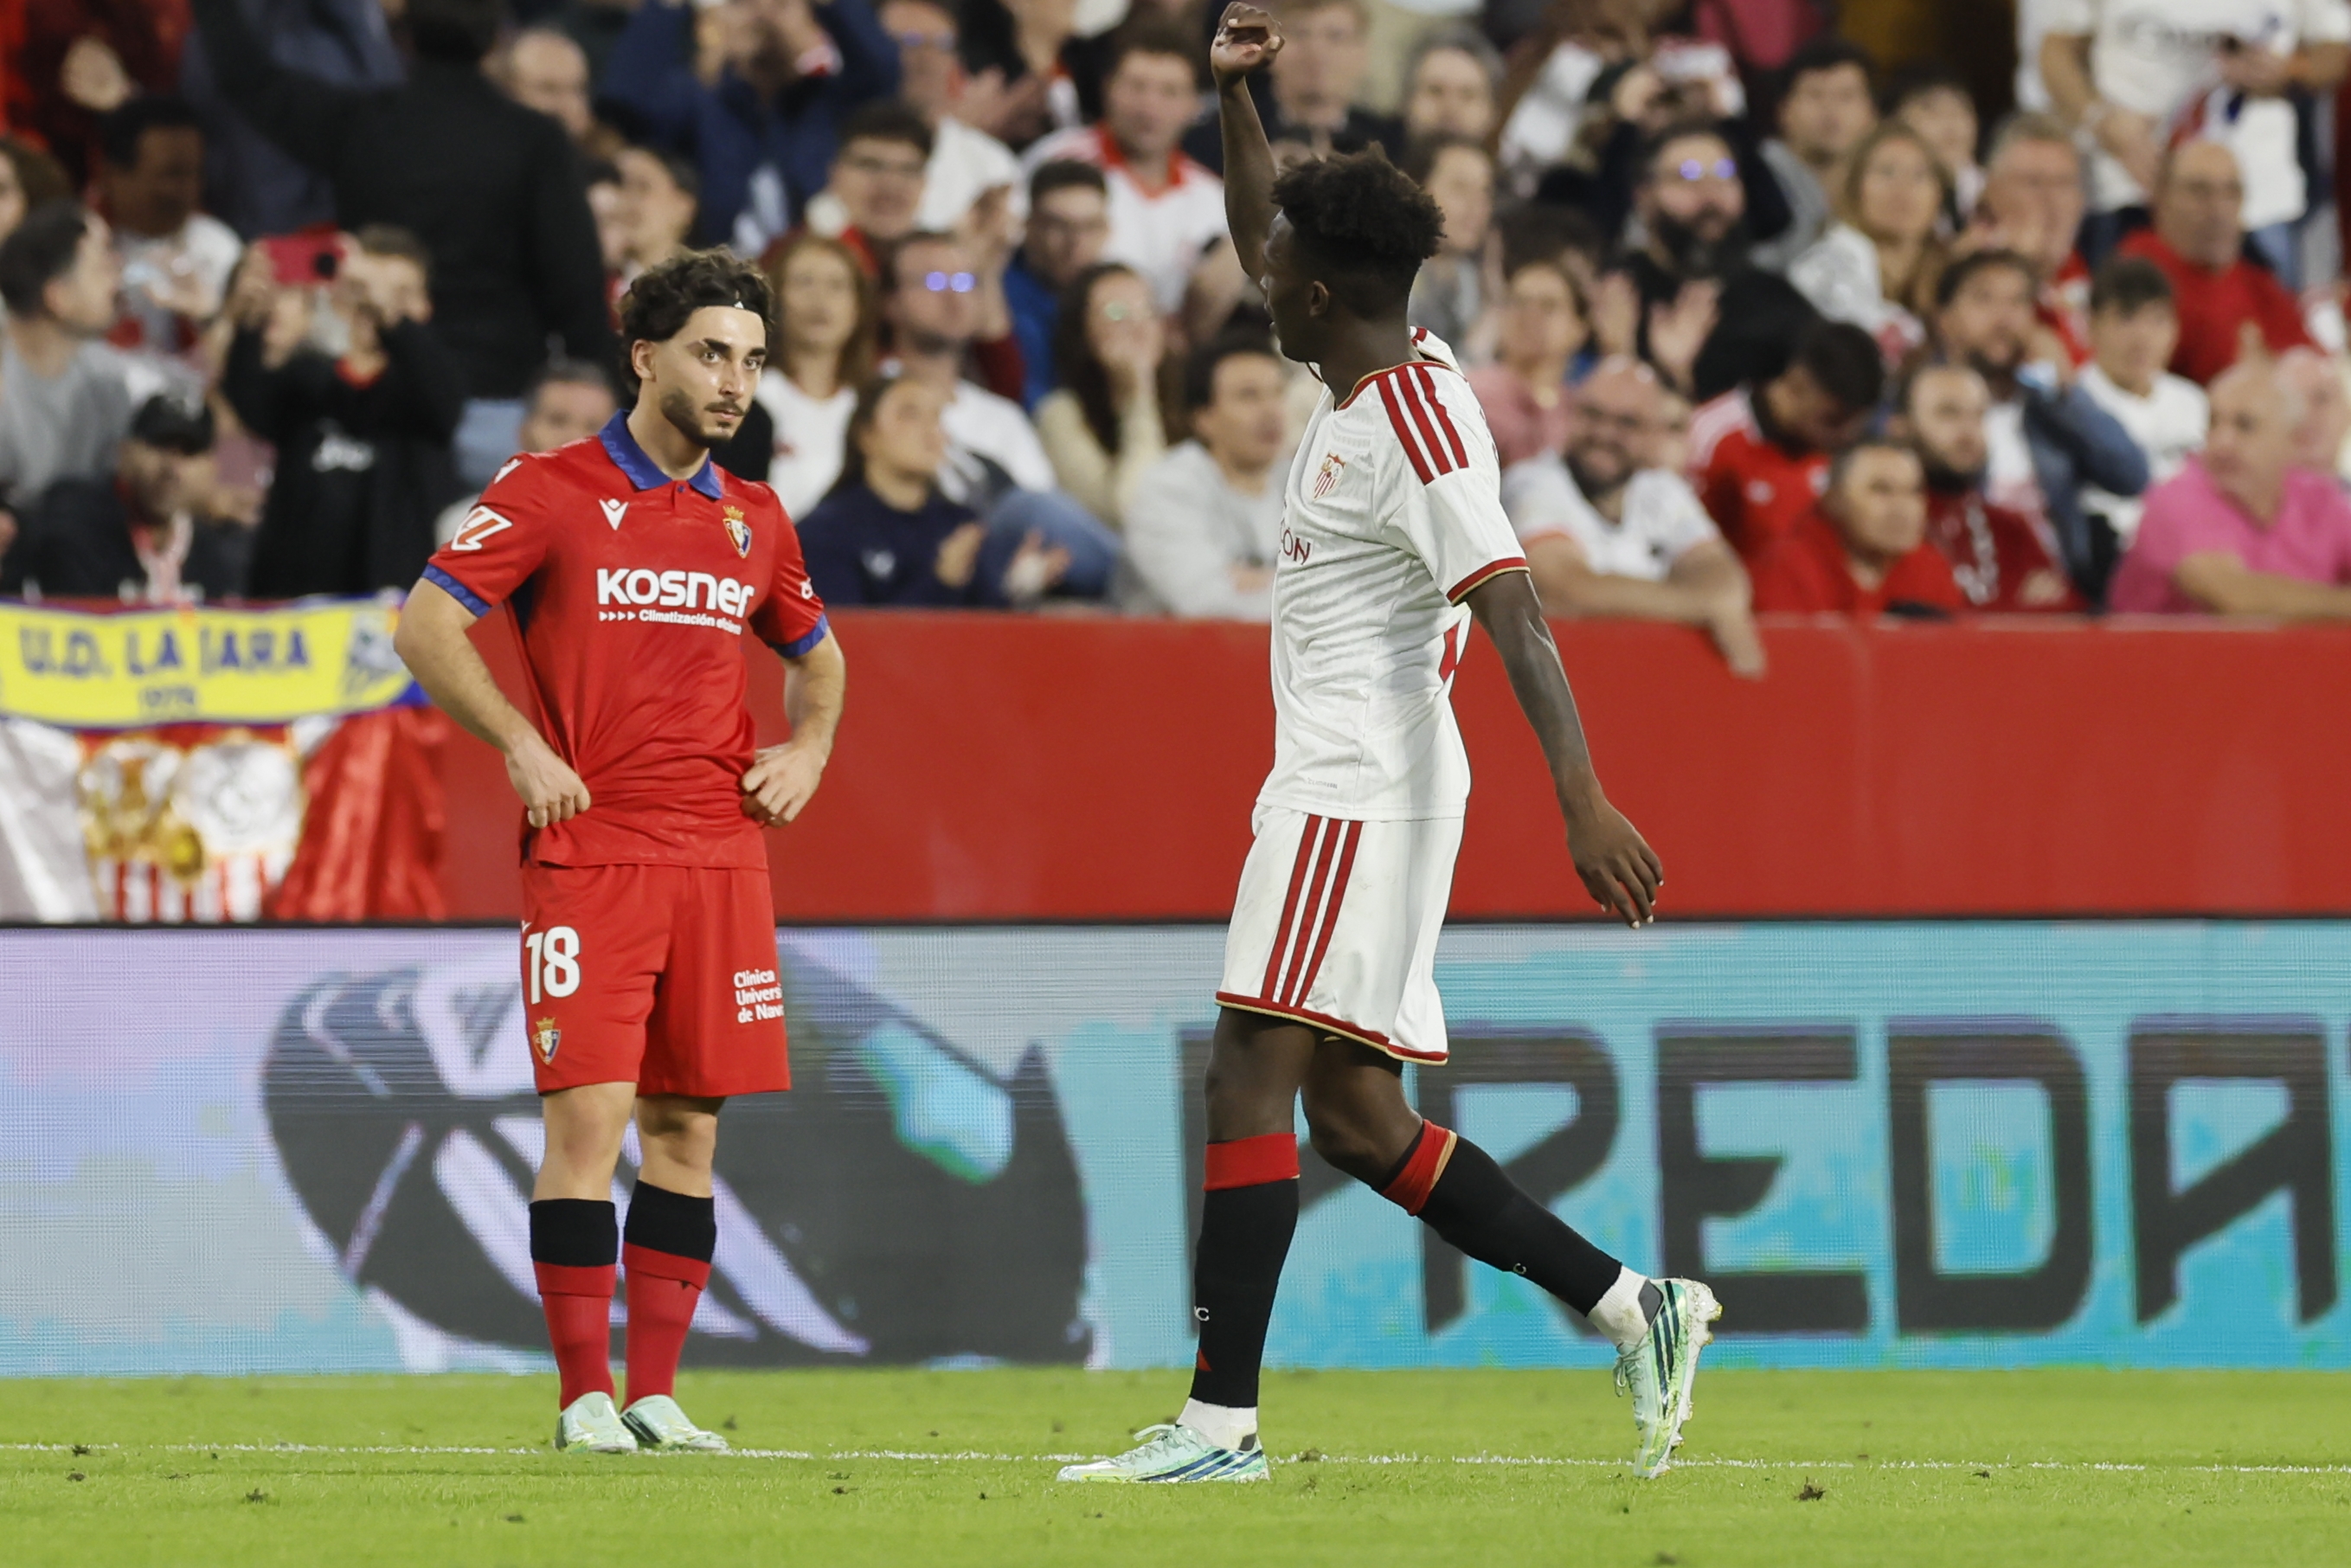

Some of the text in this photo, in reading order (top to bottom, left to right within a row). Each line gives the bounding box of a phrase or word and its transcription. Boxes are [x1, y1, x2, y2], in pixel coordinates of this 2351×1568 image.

[639, 608, 716, 627] Climatización
[525, 925, 581, 1005] 18
[738, 1006, 754, 1024] de
